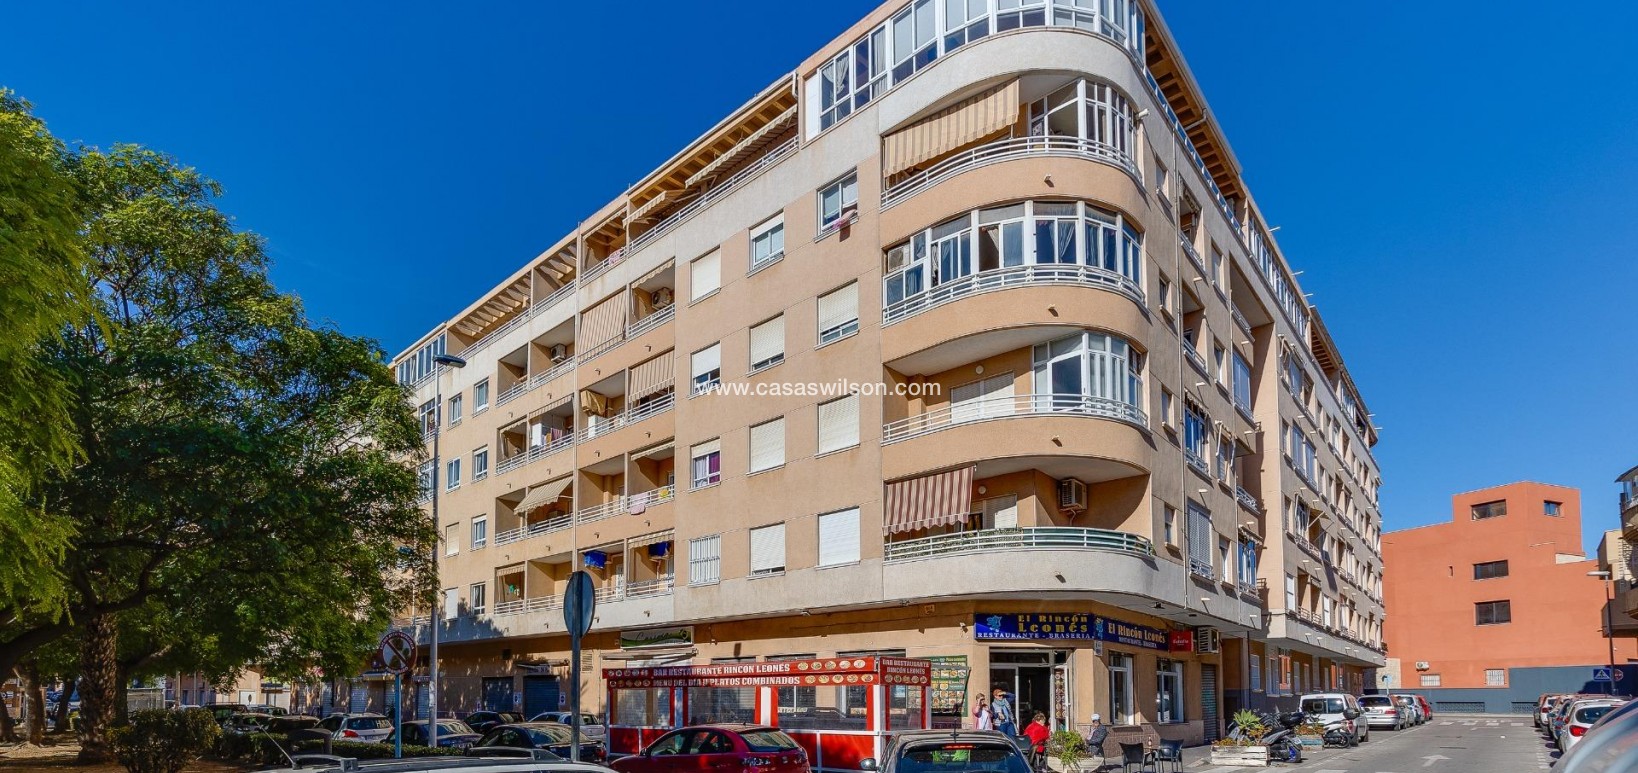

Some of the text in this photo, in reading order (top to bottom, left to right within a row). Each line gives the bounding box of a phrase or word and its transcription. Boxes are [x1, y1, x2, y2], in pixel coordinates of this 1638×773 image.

[653, 668, 667, 677] BAR
[668, 666, 722, 677] RESTAURANTE
[674, 679, 687, 687] DEL
[709, 678, 740, 686] PLATOS
[741, 676, 800, 686] COMBINADOS
